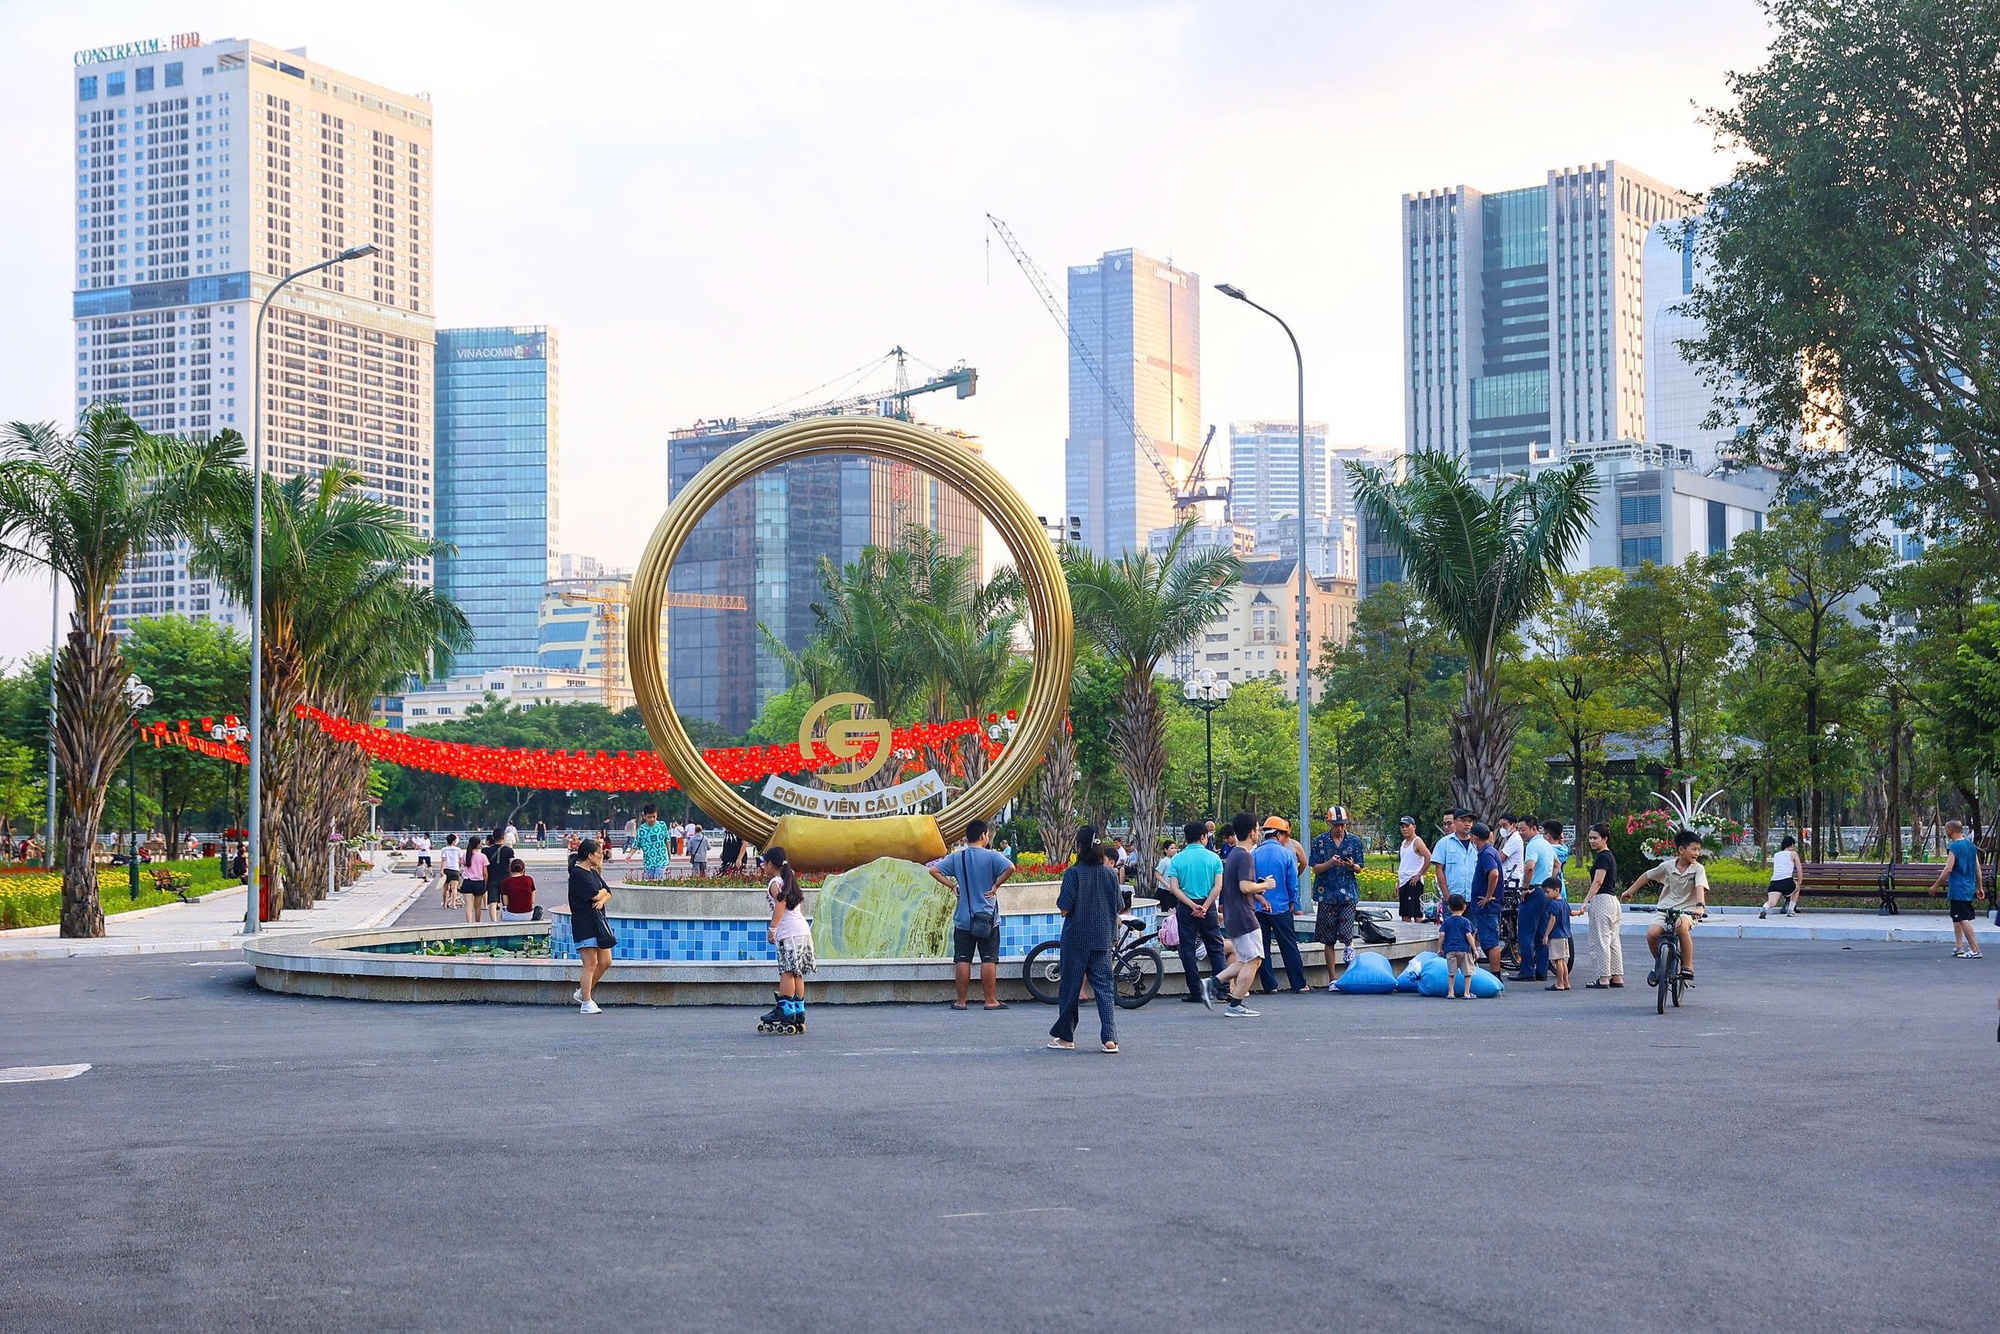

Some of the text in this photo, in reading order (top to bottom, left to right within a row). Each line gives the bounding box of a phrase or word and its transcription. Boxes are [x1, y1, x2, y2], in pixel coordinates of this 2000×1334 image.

[74, 38, 159, 67] CONSTREXIM
[171, 31, 200, 50] HOD
[456, 346, 517, 359] VINACOMIN
[773, 785, 819, 809] CÔNG
[823, 797, 860, 813] VIÊN
[901, 780, 936, 804] GIẤY
